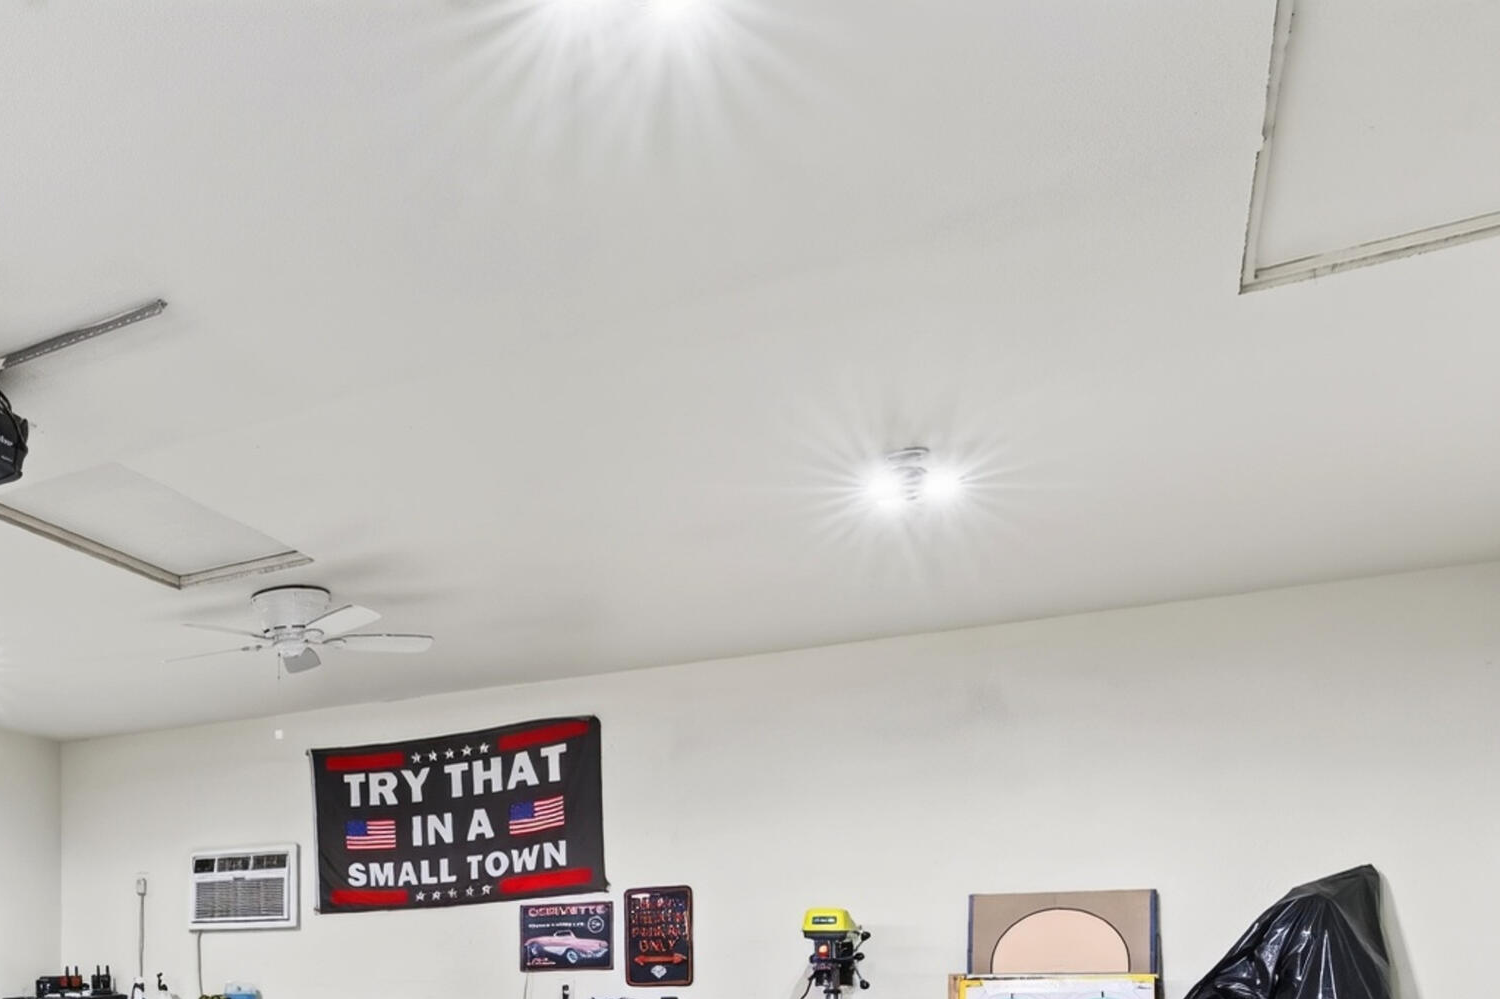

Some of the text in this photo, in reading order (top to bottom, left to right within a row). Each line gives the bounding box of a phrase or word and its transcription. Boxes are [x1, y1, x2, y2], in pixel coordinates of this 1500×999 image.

[343, 743, 567, 807] TRY THAT
[411, 808, 495, 847] IN A
[347, 840, 567, 888] SMALL TOWN
